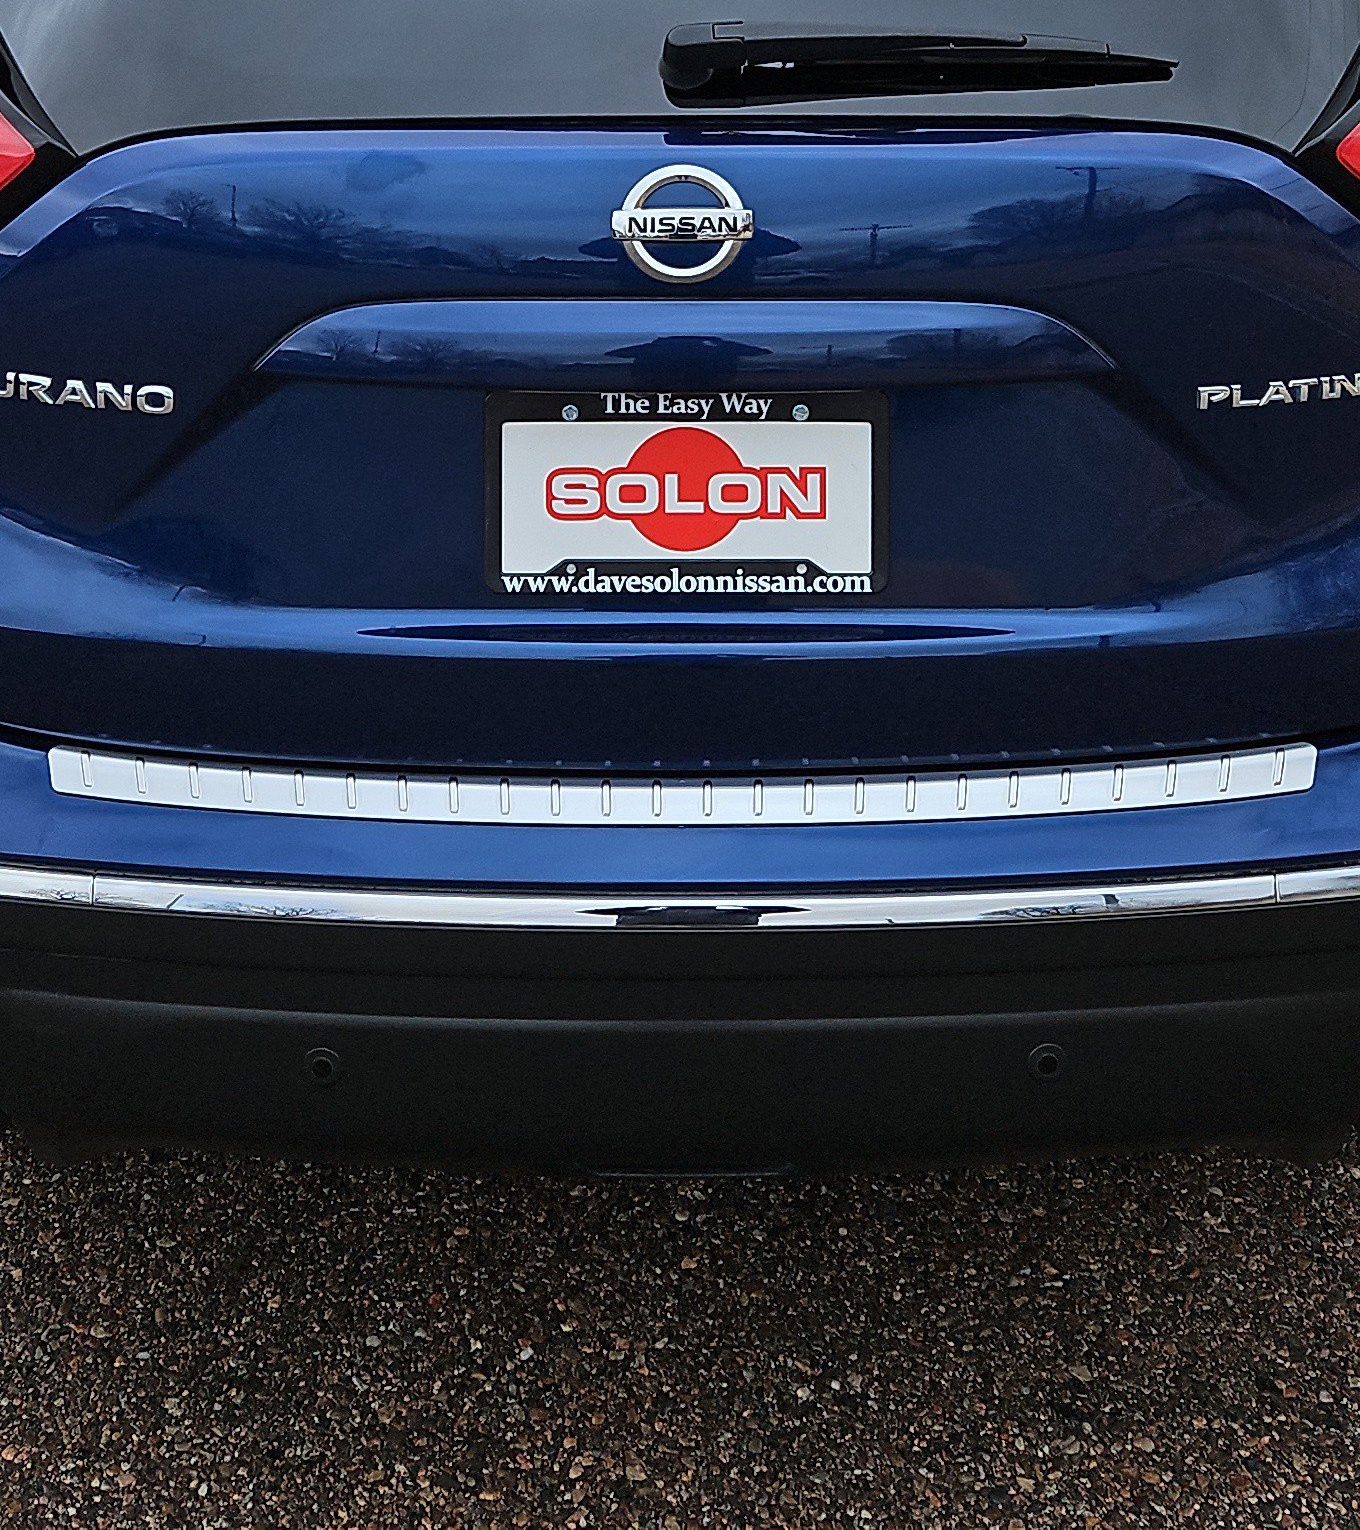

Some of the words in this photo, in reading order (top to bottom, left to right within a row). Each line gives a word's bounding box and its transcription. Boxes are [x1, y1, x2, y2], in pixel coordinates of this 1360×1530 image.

[627, 216, 738, 234] NISSAN
[600, 392, 650, 415] The
[656, 392, 715, 419] Easy
[719, 392, 773, 419] Way
[547, 469, 826, 519] SOLON
[500, 567, 873, 594] www.davesolonnissan.com
